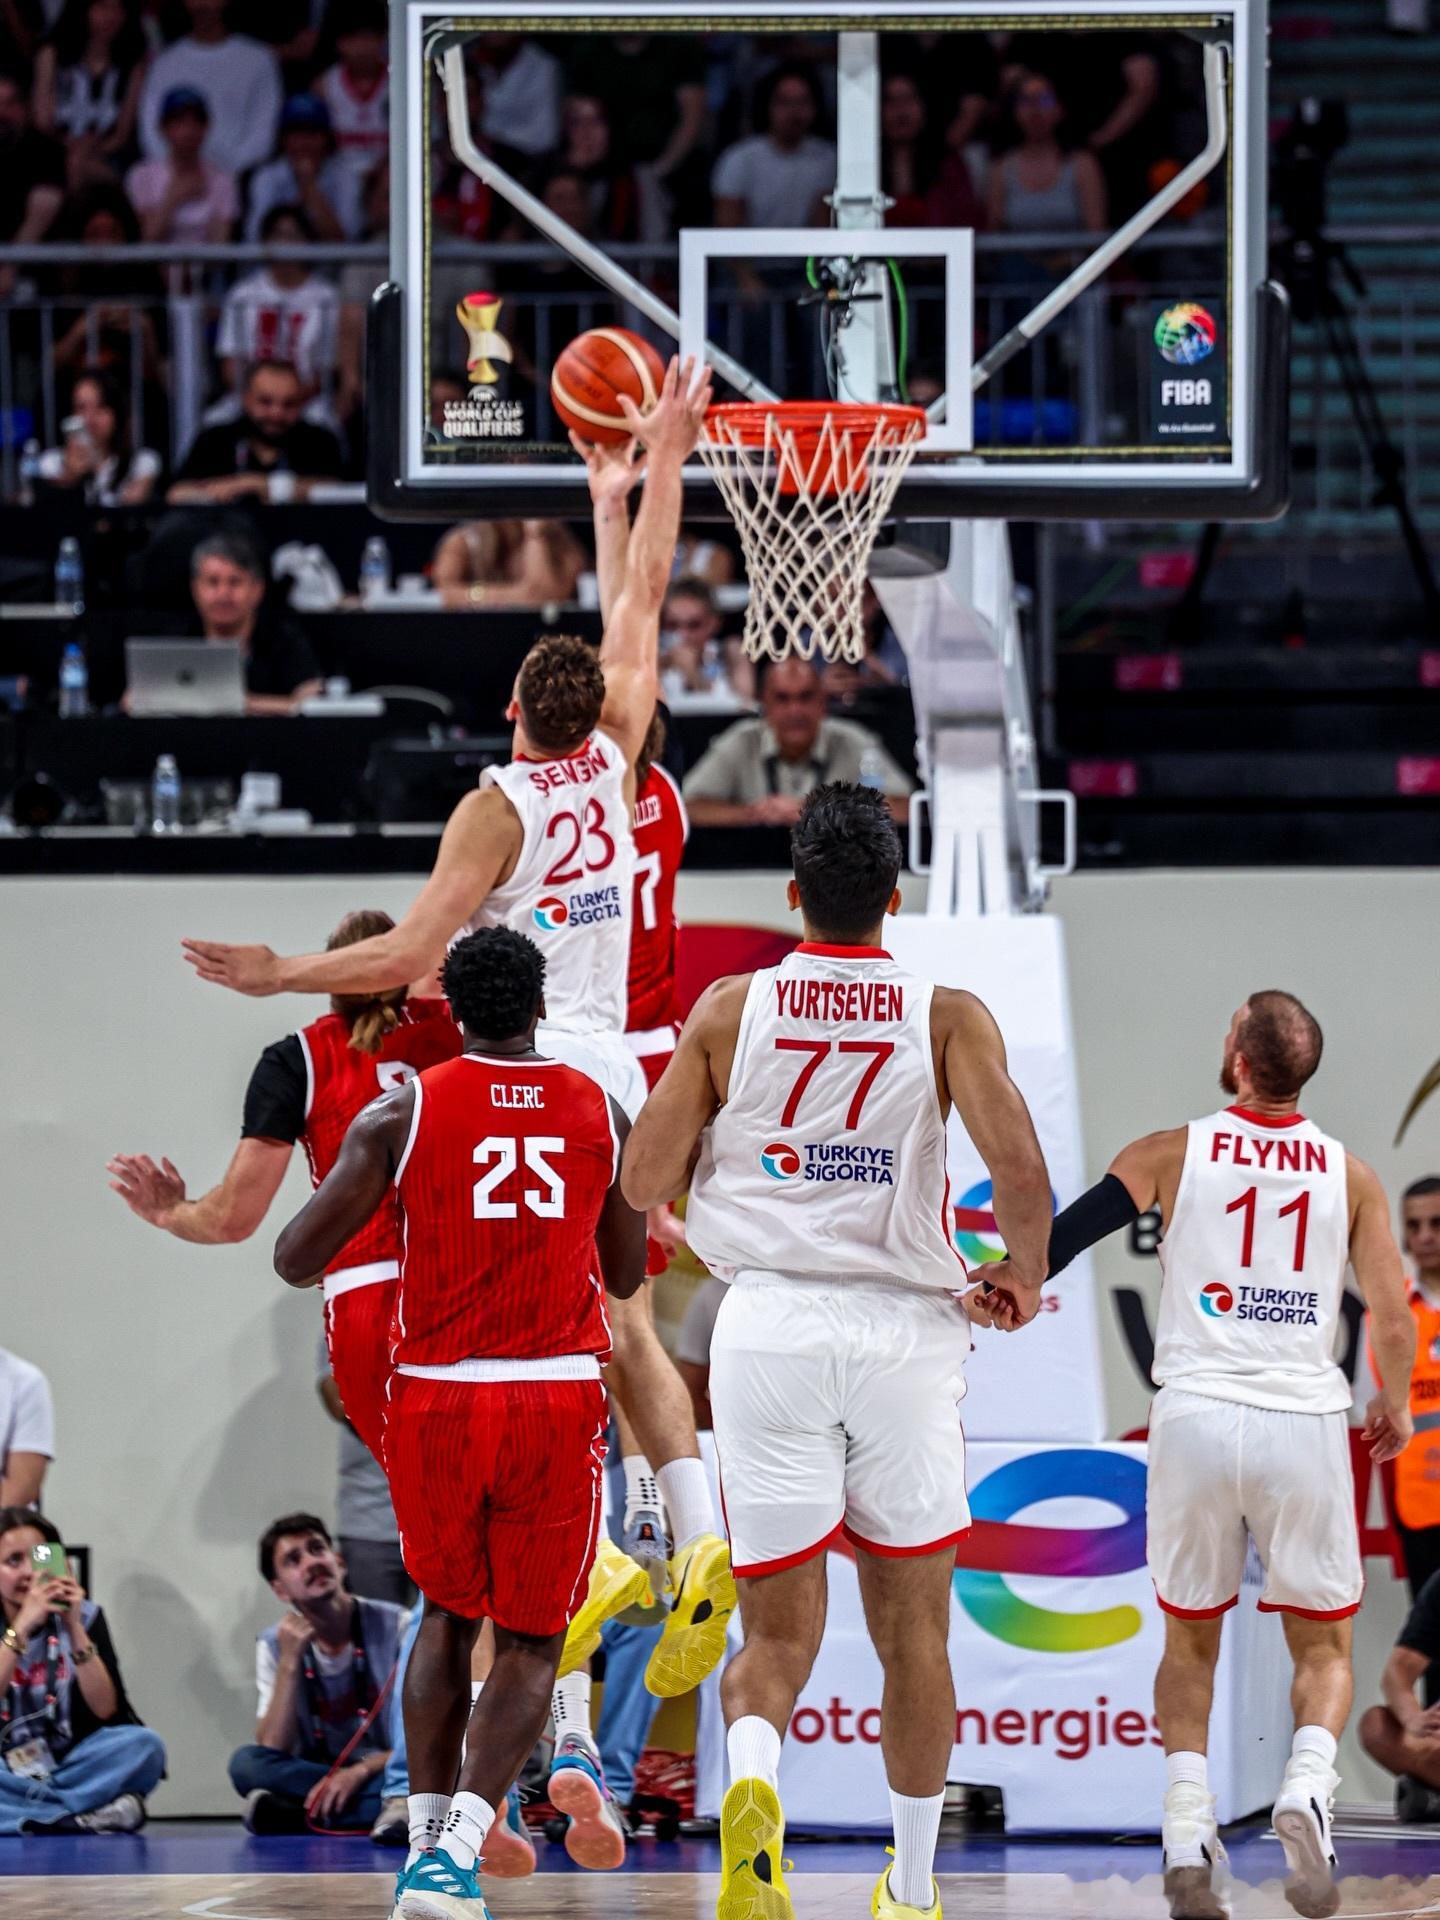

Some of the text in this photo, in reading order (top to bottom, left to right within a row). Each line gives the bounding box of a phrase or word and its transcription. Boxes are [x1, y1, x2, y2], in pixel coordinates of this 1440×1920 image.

[1161, 378, 1211, 406] FIBA
[443, 408, 524, 421] WORLD CUP
[443, 420, 524, 438] QUALIFIERS
[543, 797, 615, 887] 23
[776, 980, 903, 1022] YURTSEVEN
[490, 1084, 545, 1109] CLERC
[775, 1038, 895, 1131] 77
[1210, 1132, 1327, 1173] FLYNN
[473, 1136, 566, 1219] 25
[1225, 1186, 1310, 1272] 11
